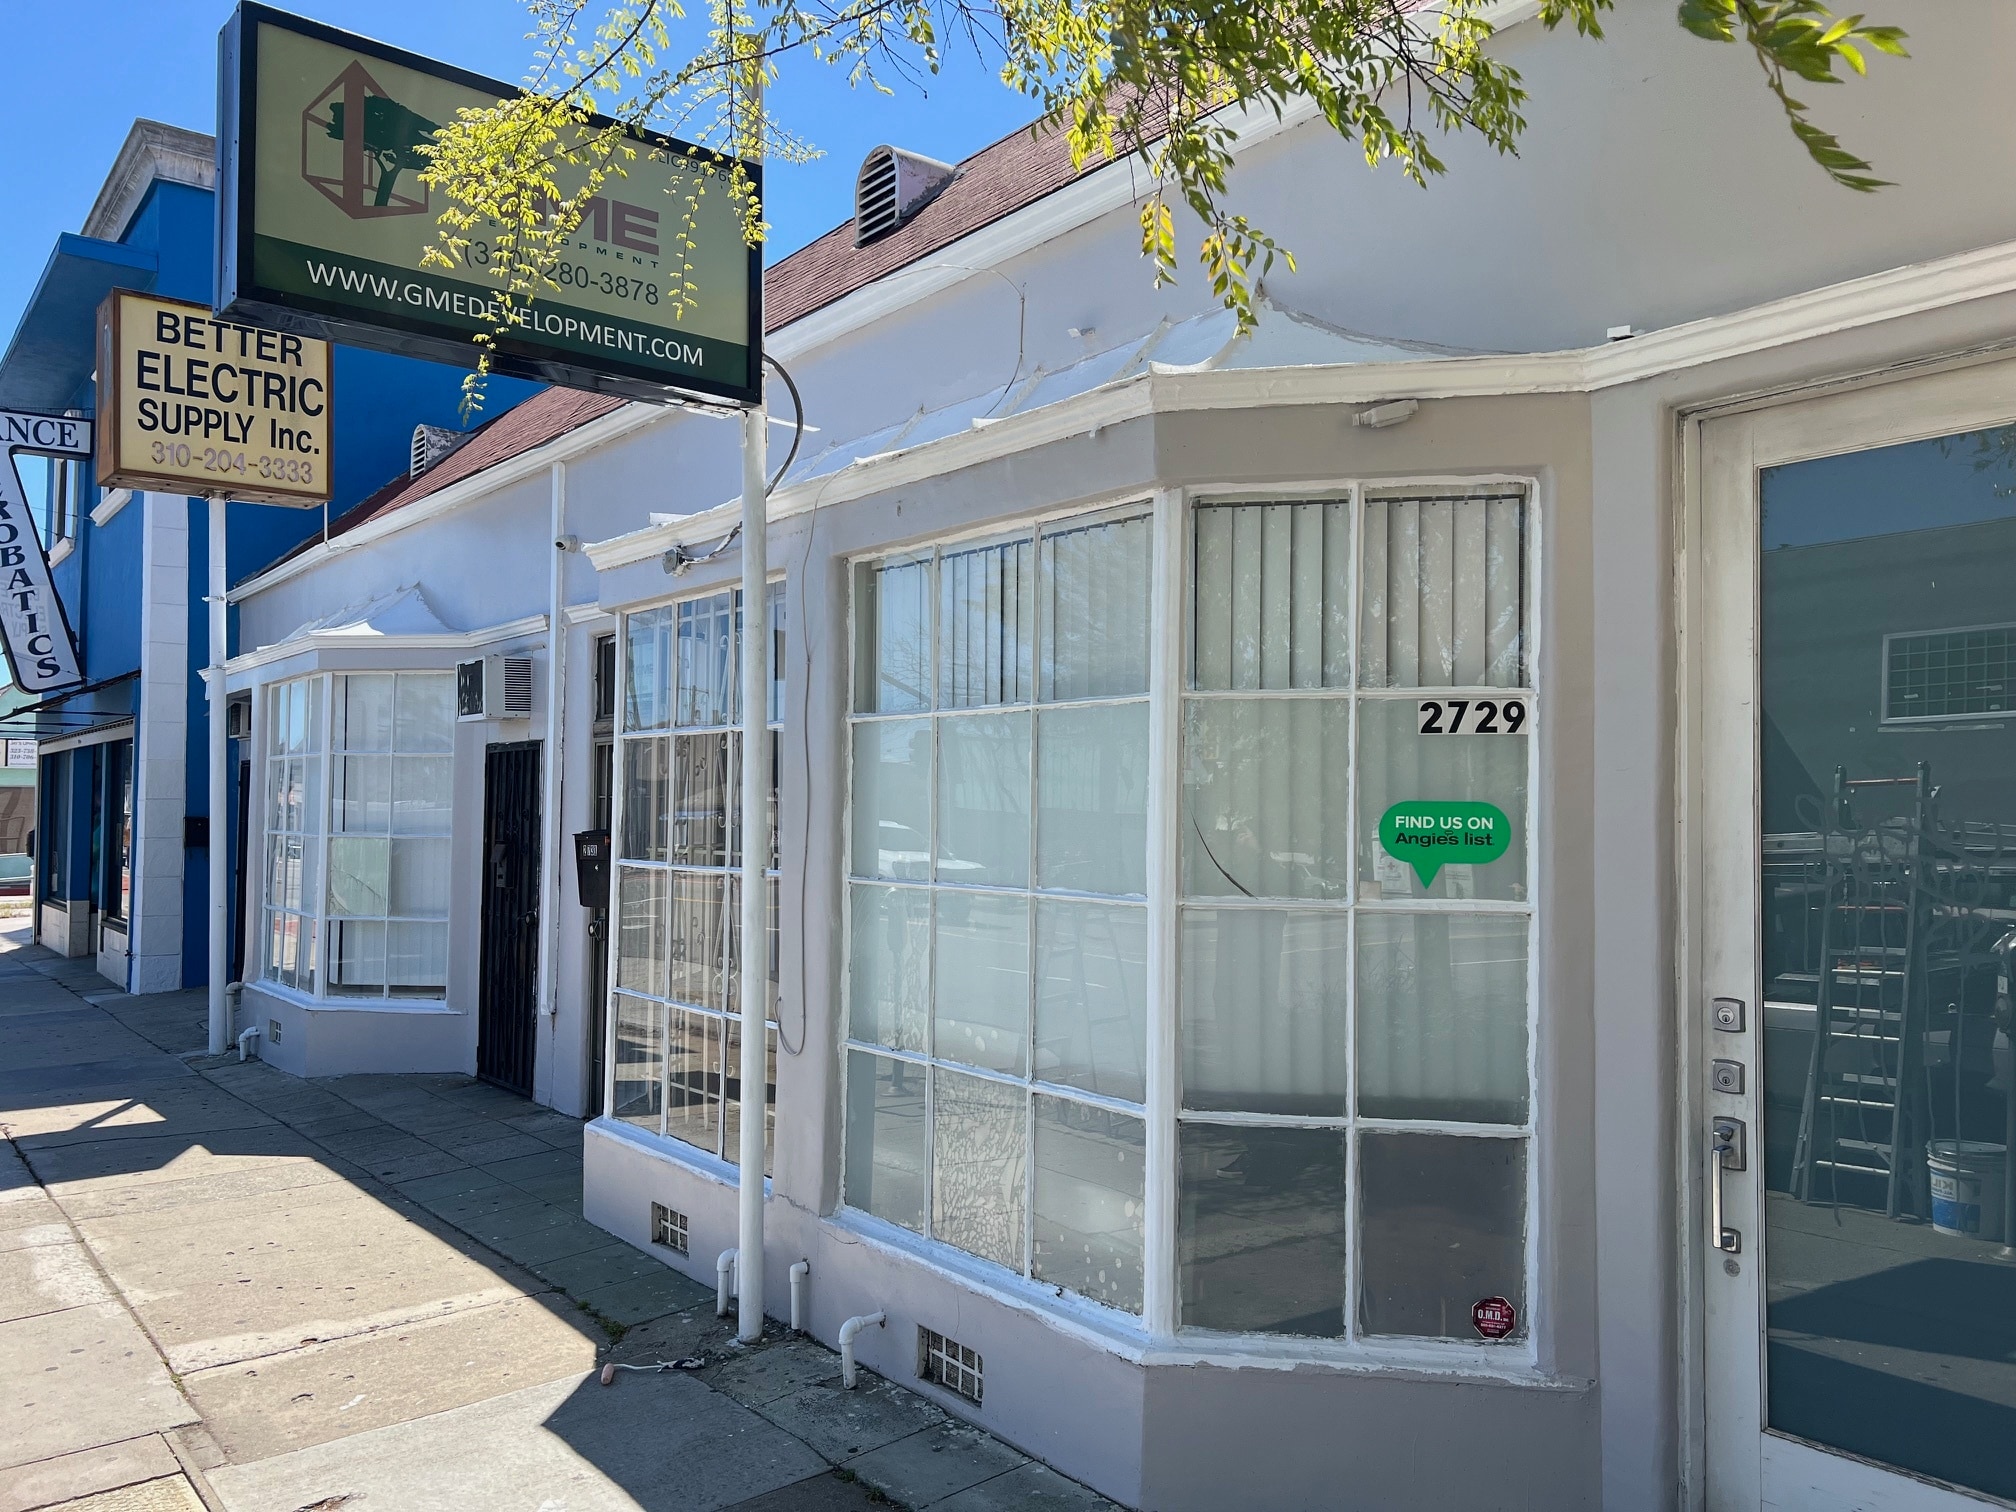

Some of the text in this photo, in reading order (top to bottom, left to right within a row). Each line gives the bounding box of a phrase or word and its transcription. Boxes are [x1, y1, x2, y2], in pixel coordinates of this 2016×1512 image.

[460, 168, 660, 256] ME
[543, 261, 660, 306] 280-3878
[156, 310, 303, 367] BETTER
[306, 260, 704, 367] WWW.GMEDEVELOPMENT.COM
[137, 349, 325, 417] ELECTRIC
[0, 416, 79, 449] NCE
[137, 397, 320, 455] SUPPLY Inc.
[151, 440, 314, 485] 310-204-3333
[1420, 700, 1527, 734] 2729
[1395, 815, 1494, 830] FIND US ON
